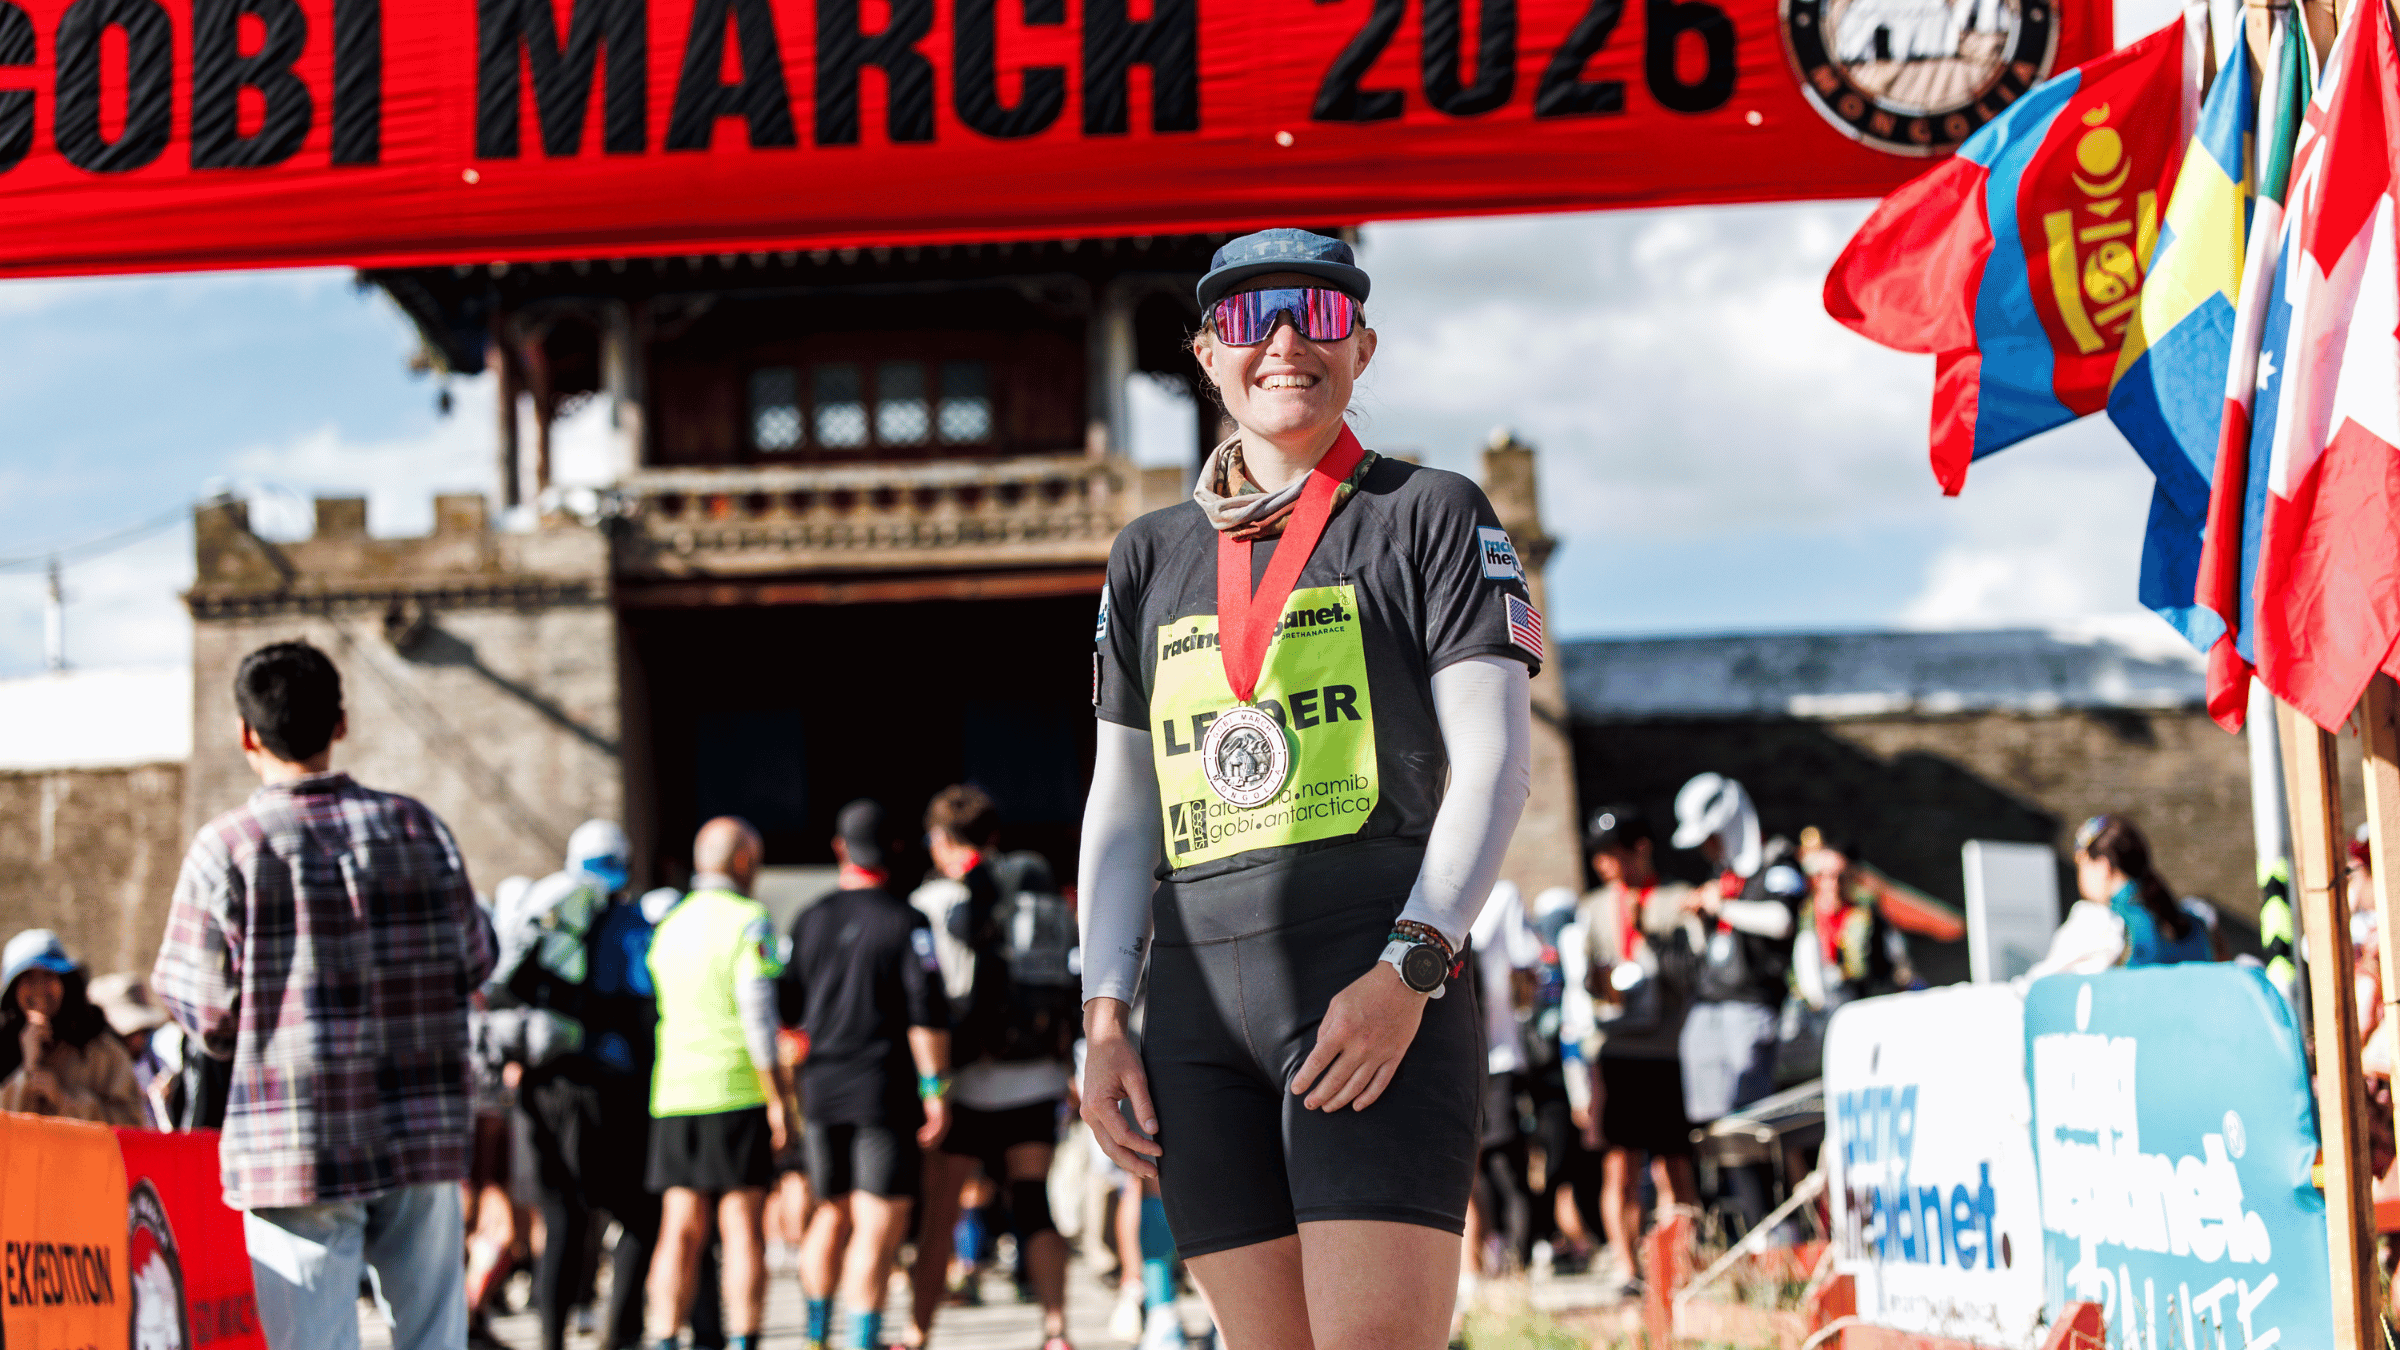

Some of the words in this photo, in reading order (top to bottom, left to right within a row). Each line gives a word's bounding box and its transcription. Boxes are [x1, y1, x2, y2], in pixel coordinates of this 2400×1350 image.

[474, 0, 1200, 159] MARCH
[1309, 0, 1738, 123] 2026
[1163, 684, 1362, 757] LEDER
[1212, 718, 1233, 739] GOBI
[1240, 714, 1273, 733] MARCH
[1209, 796, 1371, 843] gobi.antarctica
